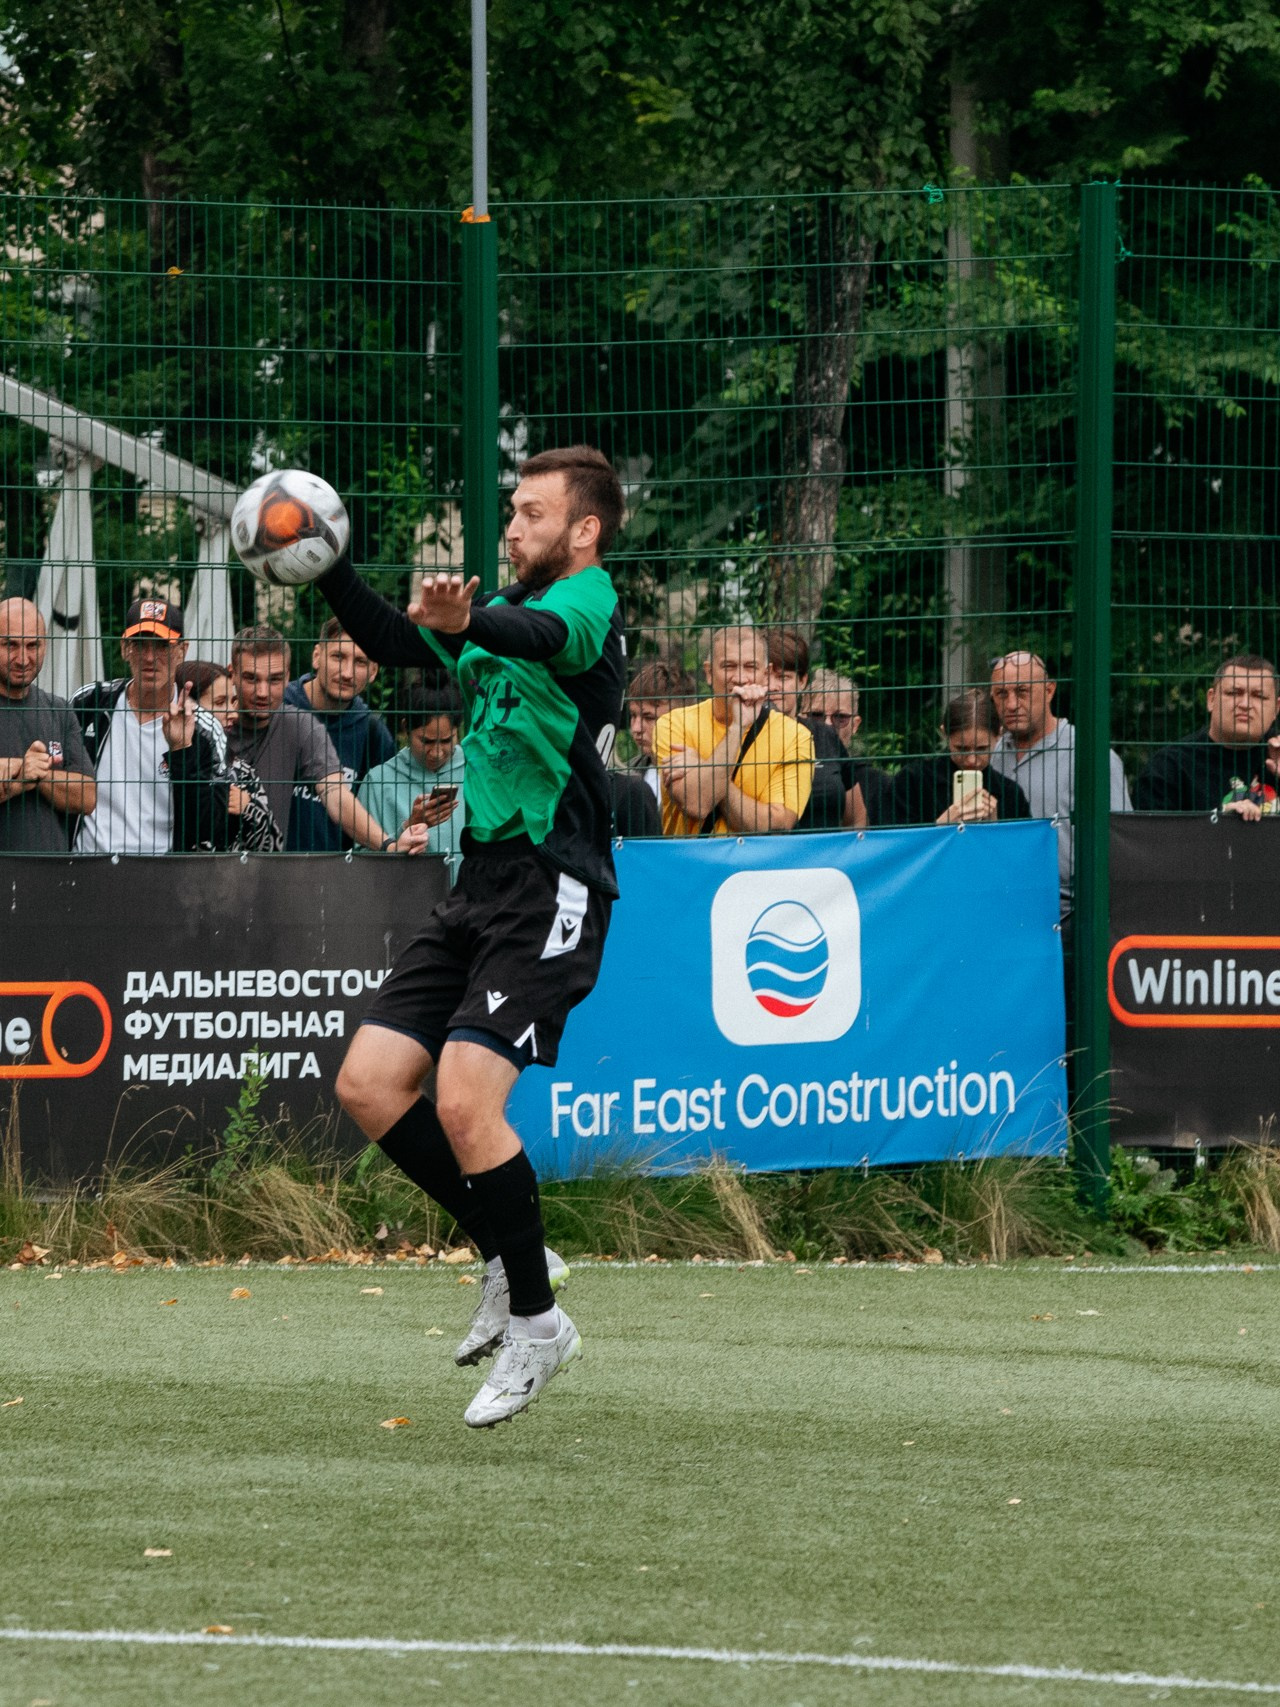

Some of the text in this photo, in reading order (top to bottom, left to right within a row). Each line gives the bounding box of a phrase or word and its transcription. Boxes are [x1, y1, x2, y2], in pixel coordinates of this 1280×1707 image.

[123, 968, 393, 1005] ДАЛЬНЕВОСТОЧ
[1128, 958, 1280, 1006] Winline
[123, 1009, 345, 1040] ФУТБОЛЬНАЯ
[122, 1050, 322, 1087] МЕДИАЛИГА
[550, 1059, 1016, 1138] Far East Construction
